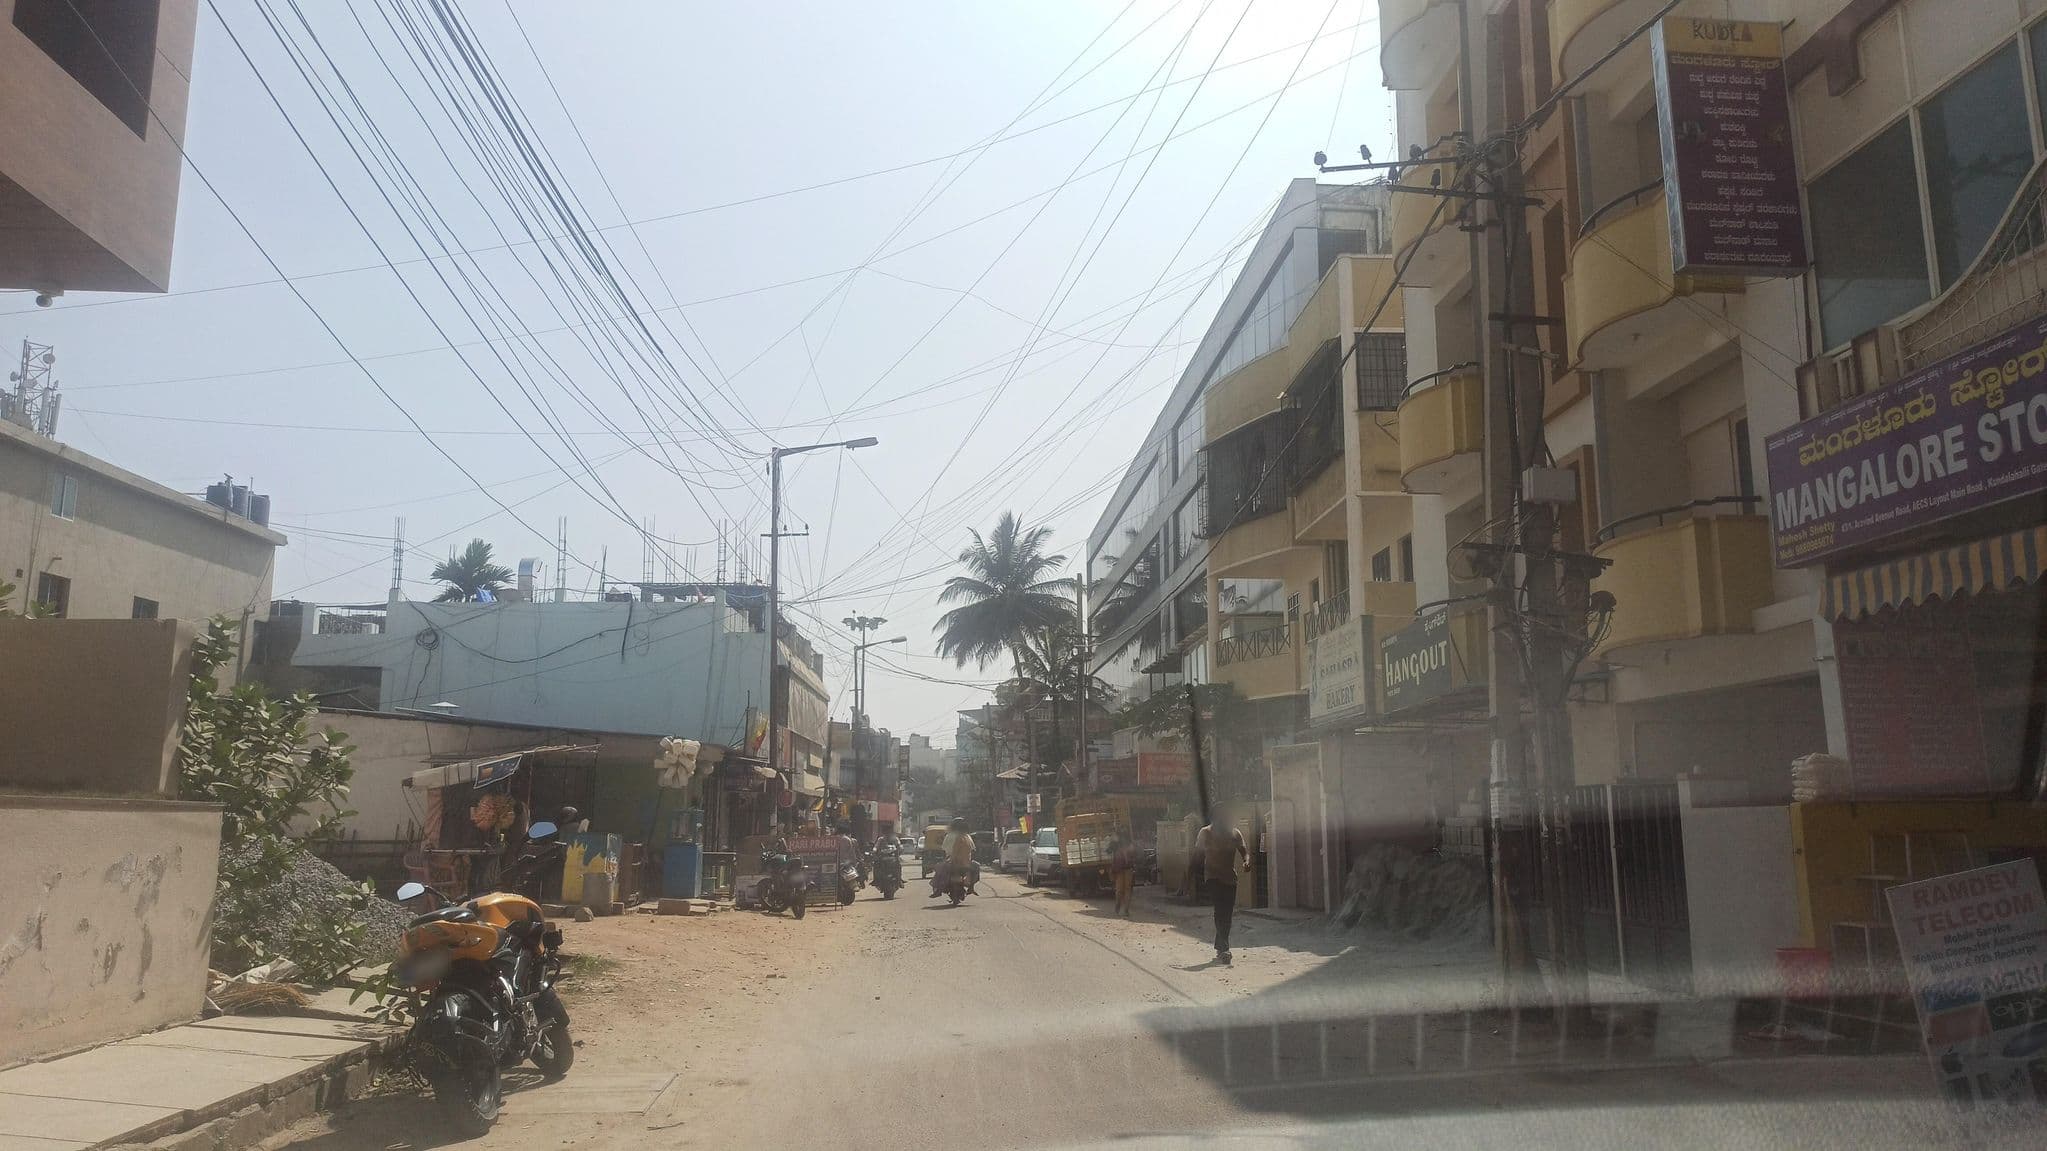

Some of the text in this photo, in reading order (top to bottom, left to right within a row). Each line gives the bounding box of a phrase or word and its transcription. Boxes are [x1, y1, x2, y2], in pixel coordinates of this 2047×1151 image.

[1692, 18, 1753, 42] KUDLA
[1799, 388, 1936, 465] ಮಂಗಳೂರು
[1775, 424, 1968, 532] MANGALORE
[1912, 868, 2020, 910] RAMDEV
[1912, 892, 2034, 936] TELECOM
